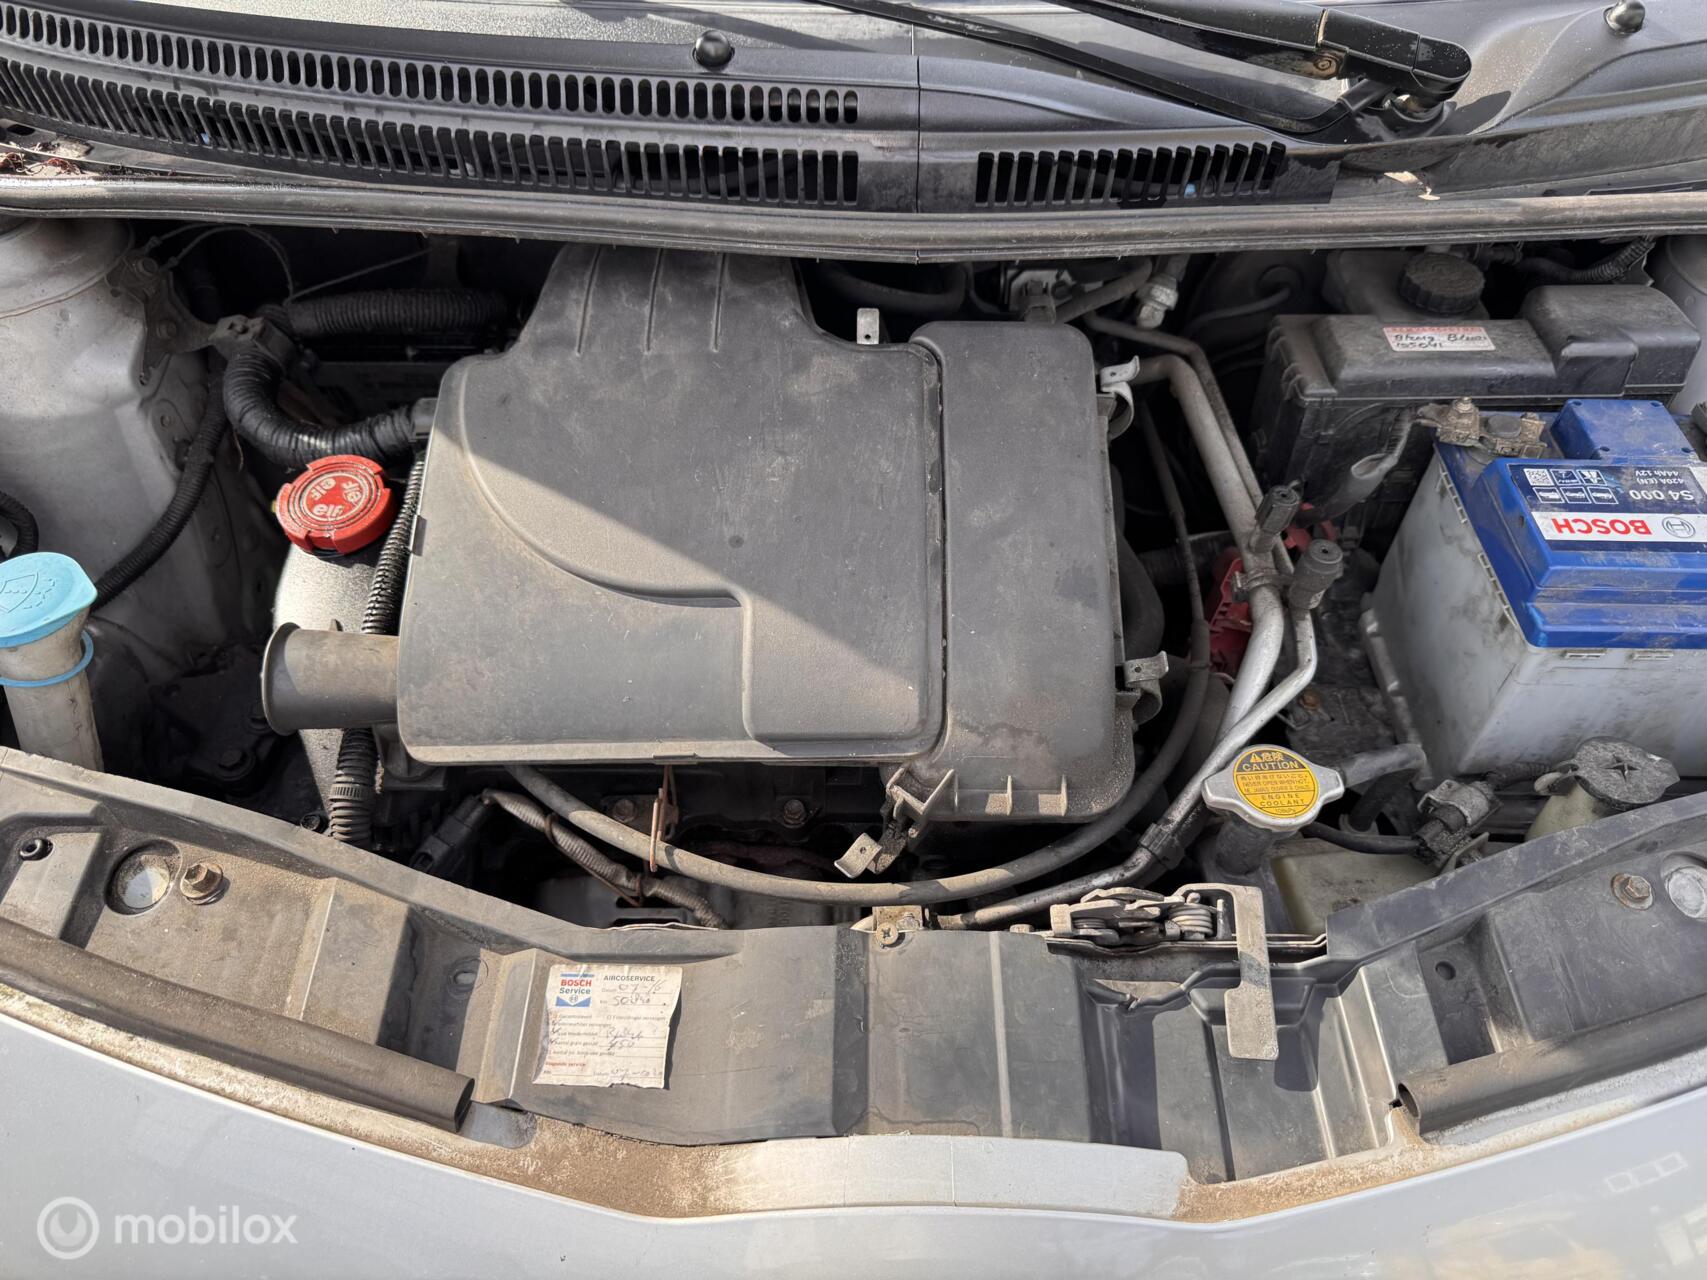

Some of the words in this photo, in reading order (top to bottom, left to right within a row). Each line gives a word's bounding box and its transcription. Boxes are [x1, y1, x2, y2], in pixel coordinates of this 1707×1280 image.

[310, 478, 337, 501] elf
[342, 481, 362, 503] elf
[1629, 489, 1665, 501] 000
[1668, 490, 1695, 501] S4
[313, 504, 345, 517] elf
[1551, 518, 1653, 536] BOSCH
[1242, 761, 1299, 772] CAUTION
[1260, 799, 1305, 807] COOLANT
[560, 979, 592, 987] BOSCH
[559, 986, 591, 995] Service
